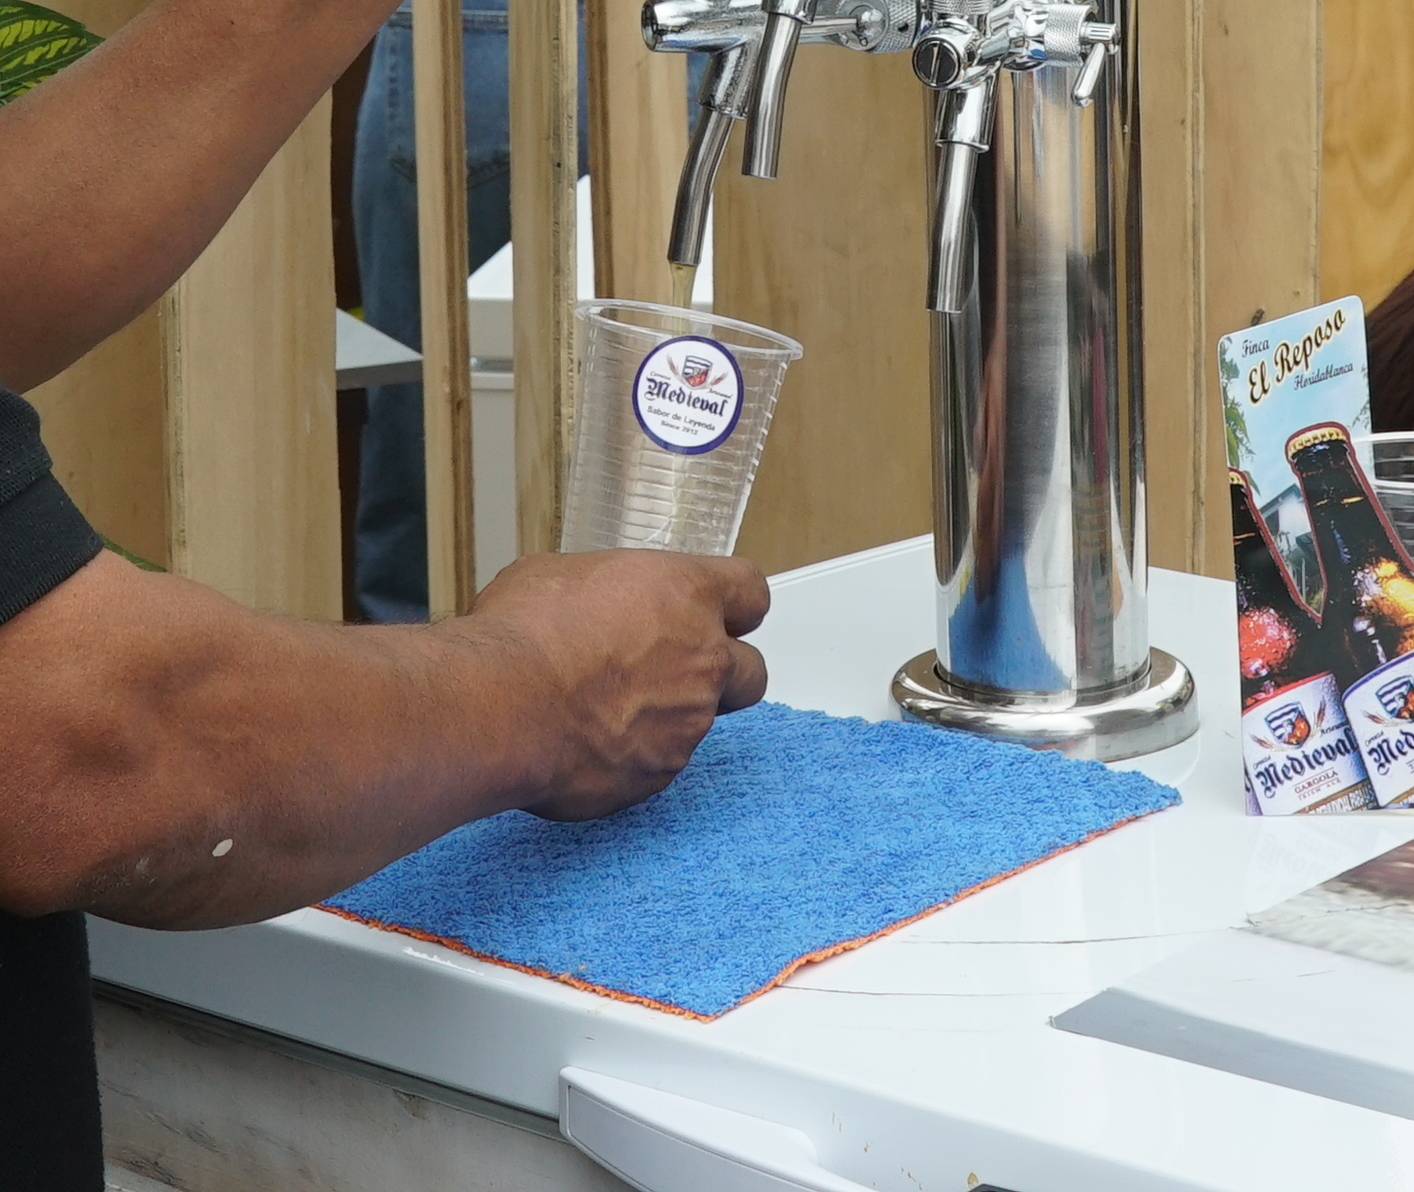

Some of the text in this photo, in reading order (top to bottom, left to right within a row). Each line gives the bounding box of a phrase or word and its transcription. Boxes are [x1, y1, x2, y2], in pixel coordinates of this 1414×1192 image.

[1242, 339, 1270, 358] Finca
[1248, 309, 1346, 404] El Reposo
[644, 377, 729, 417] Medieval
[647, 406, 715, 432] Sabor de Leyenda
[1255, 727, 1359, 799] Medieval
[1294, 769, 1339, 794] GARGOLA
